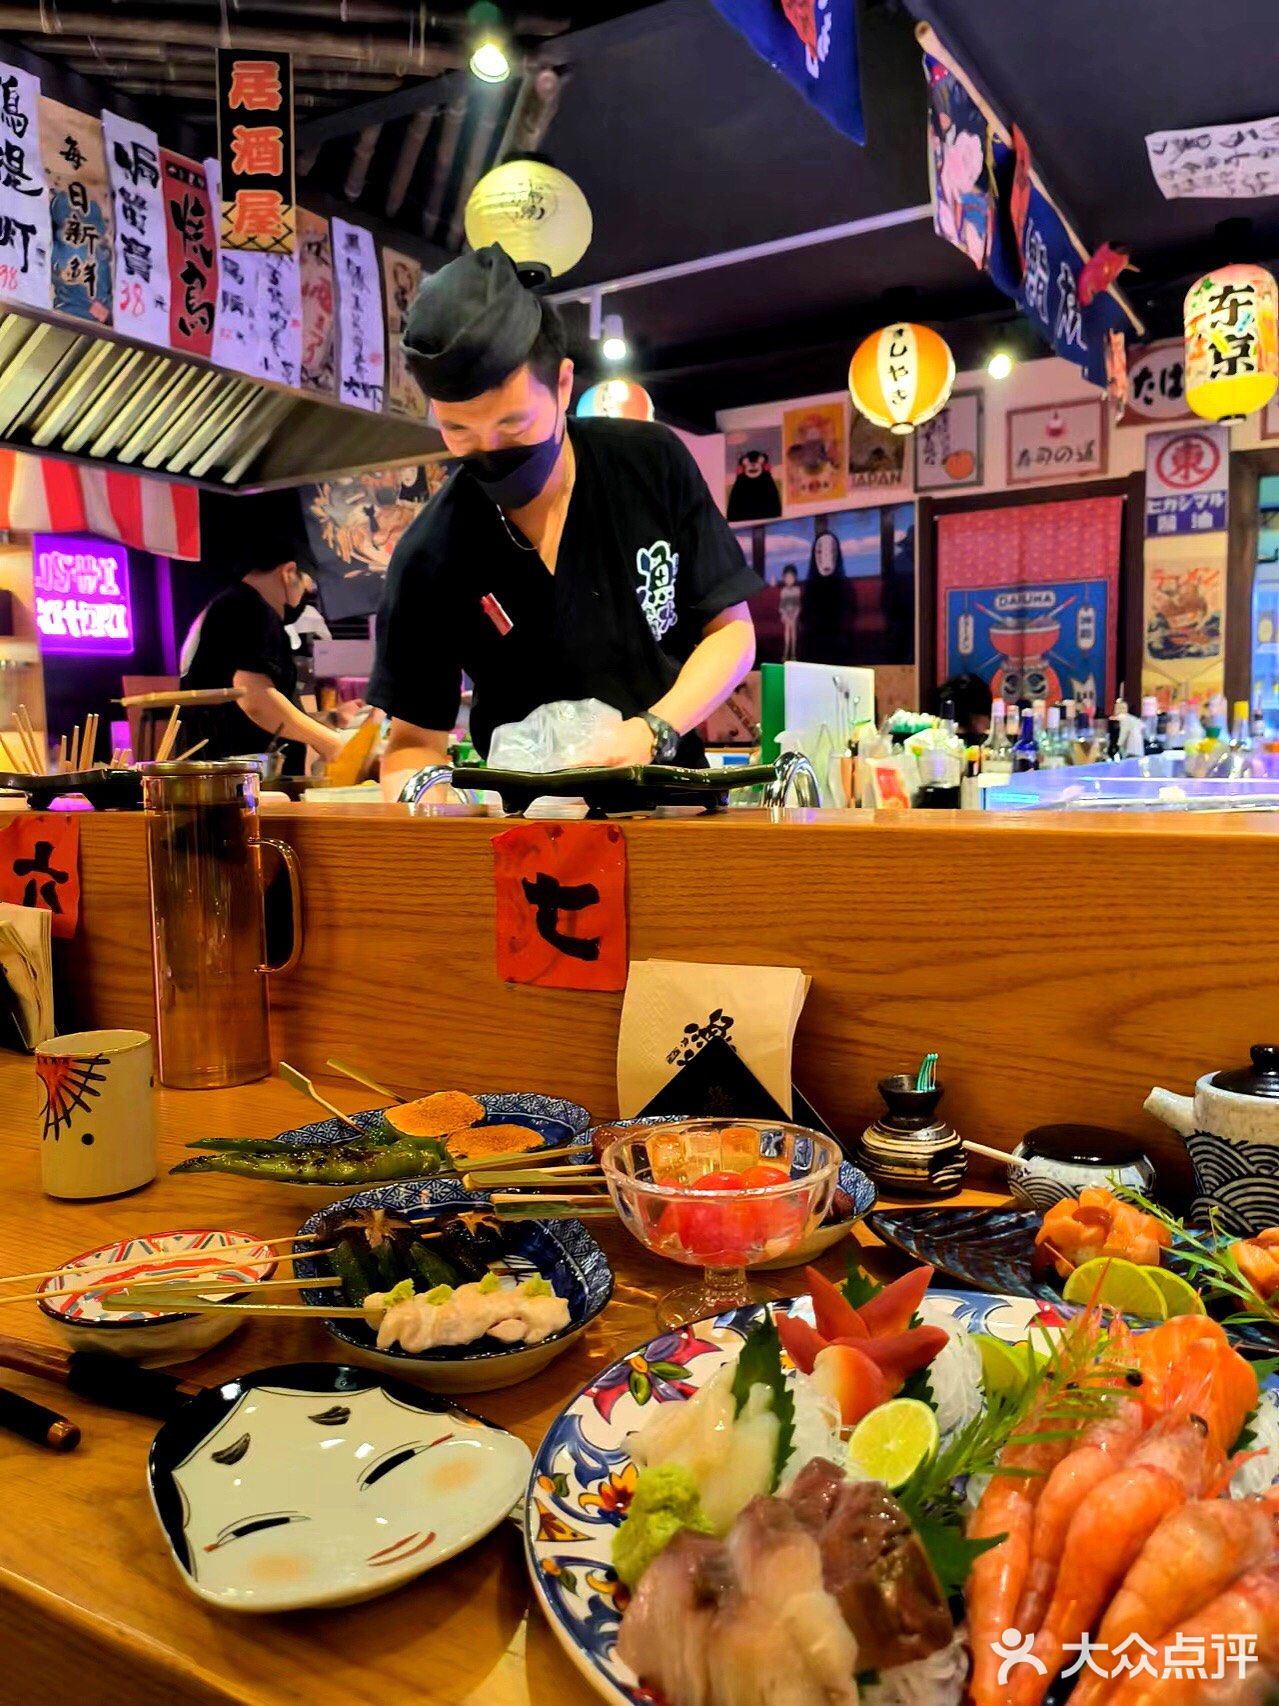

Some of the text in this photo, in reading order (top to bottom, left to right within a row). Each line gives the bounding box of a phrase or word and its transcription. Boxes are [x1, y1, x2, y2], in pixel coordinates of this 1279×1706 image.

[229, 60, 284, 238] 居酒屋
[13, 841, 69, 914] 六
[521, 872, 603, 961] 七
